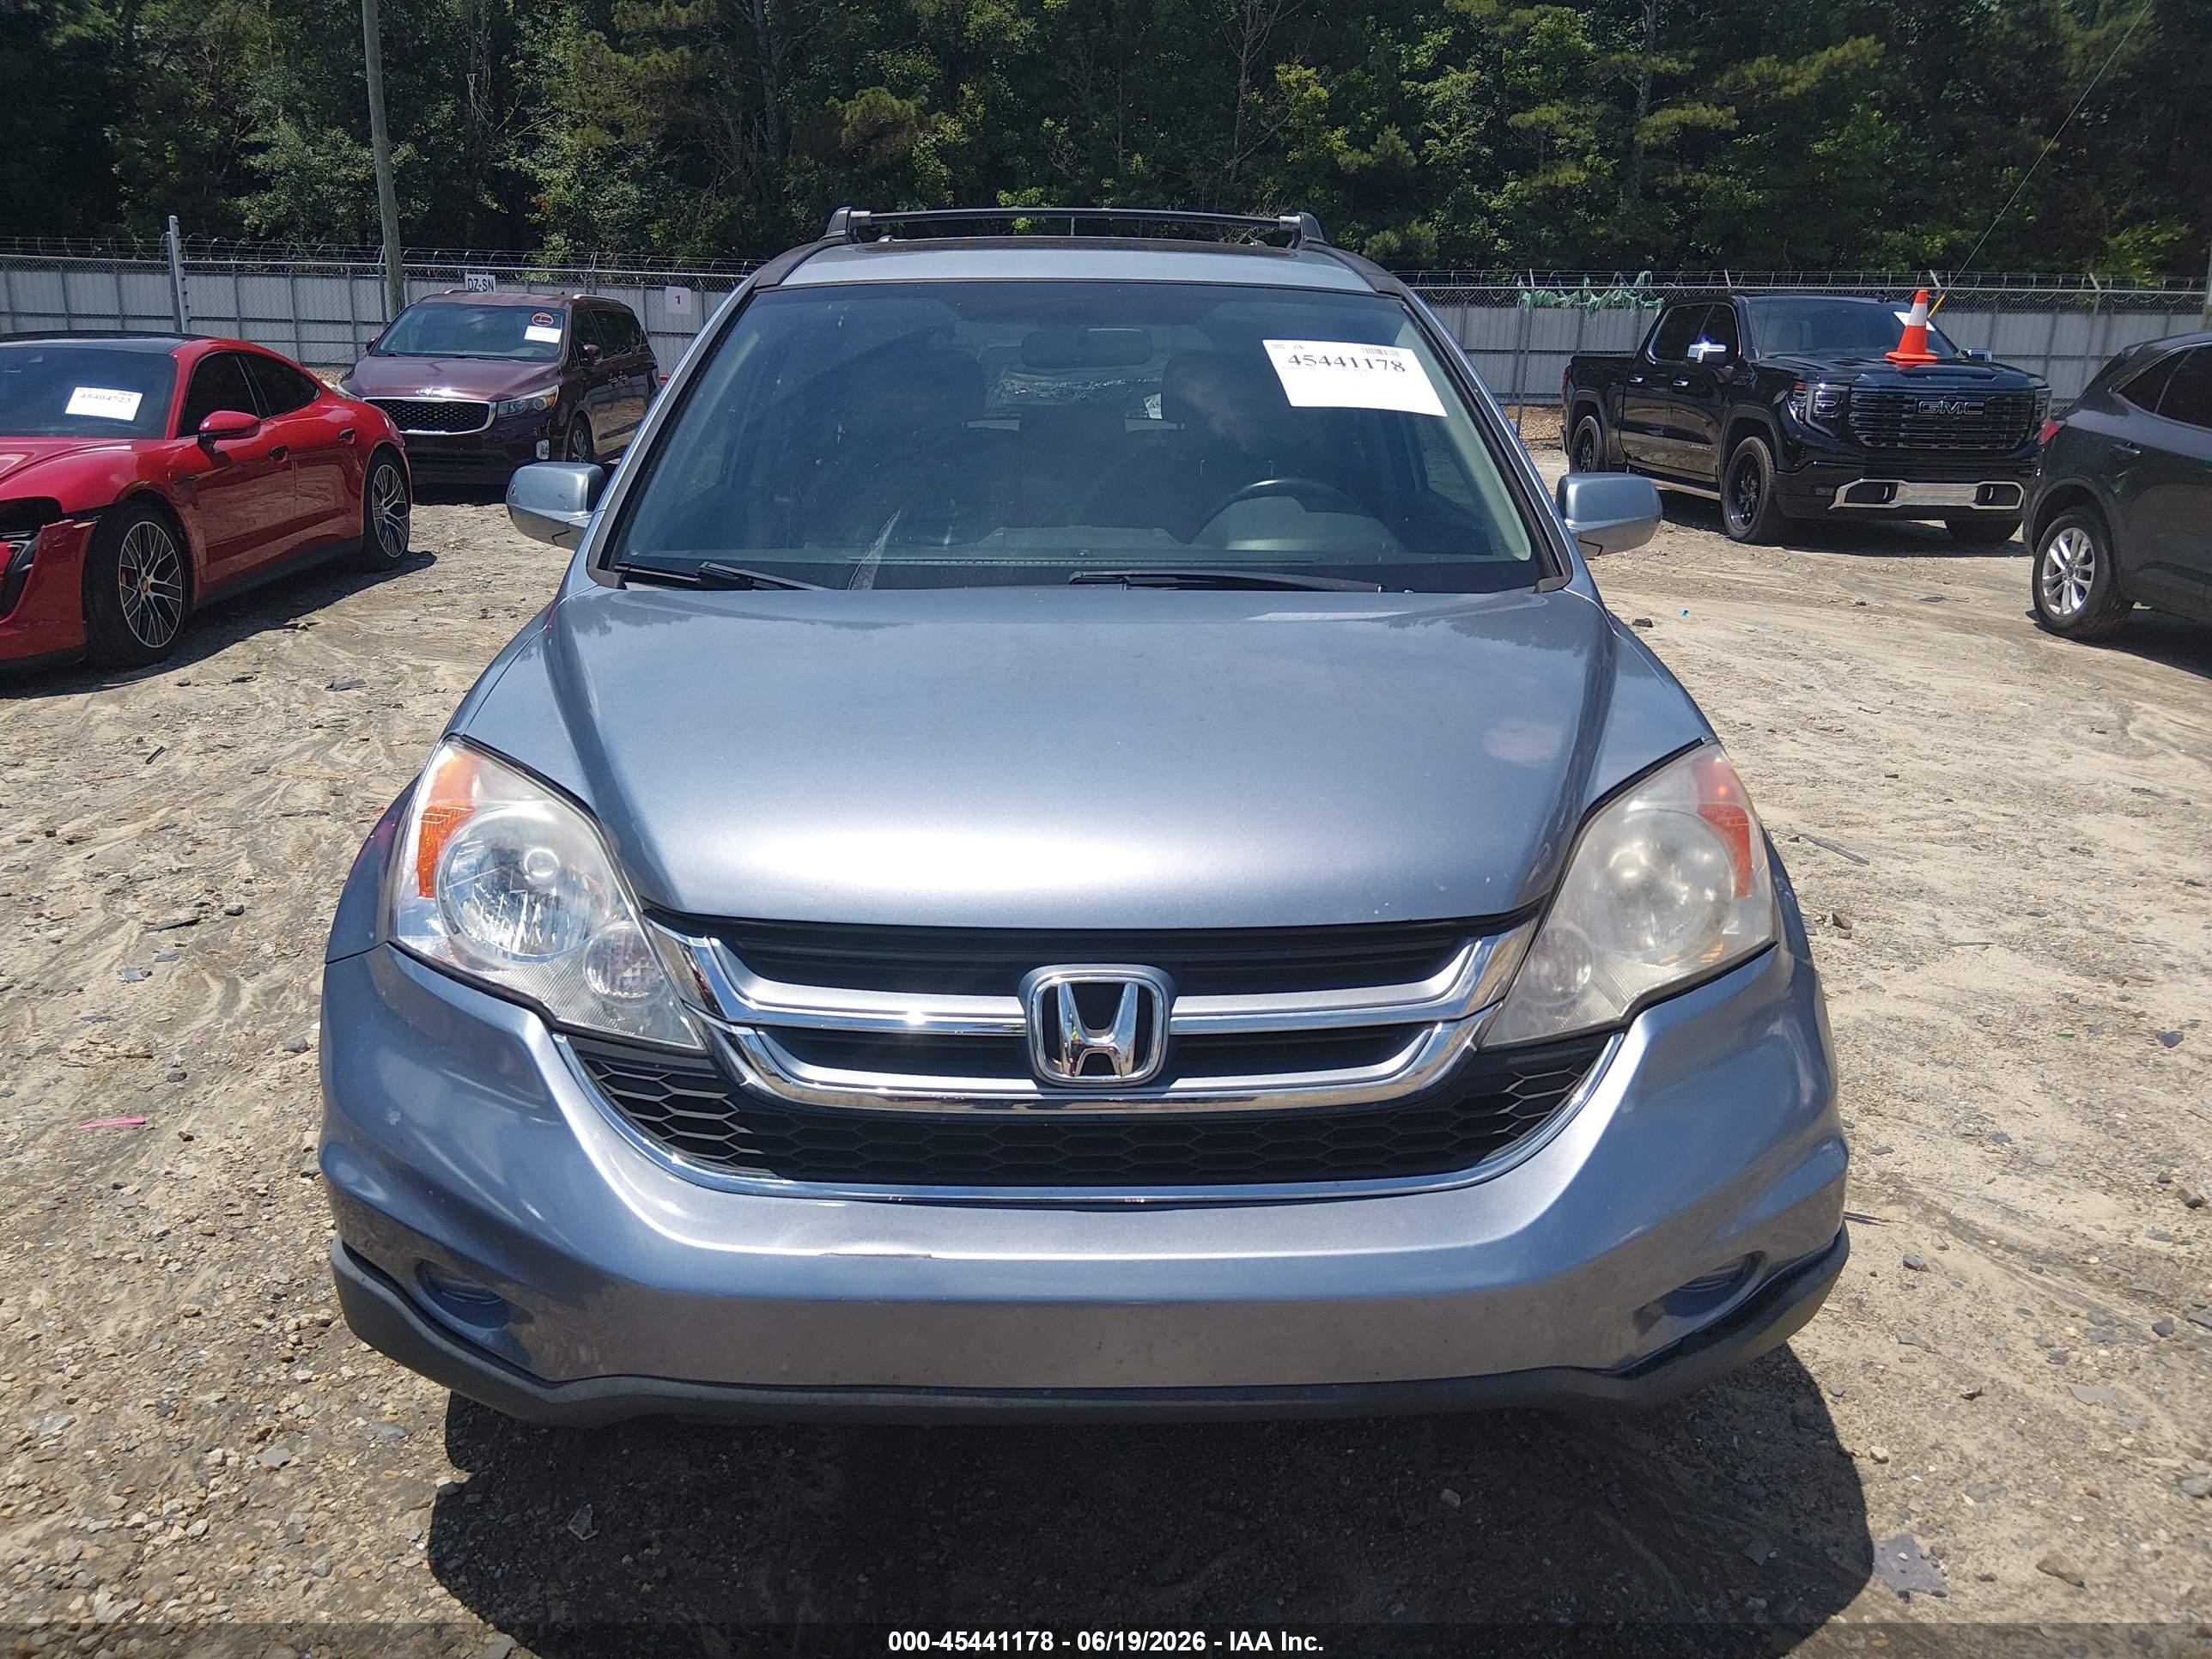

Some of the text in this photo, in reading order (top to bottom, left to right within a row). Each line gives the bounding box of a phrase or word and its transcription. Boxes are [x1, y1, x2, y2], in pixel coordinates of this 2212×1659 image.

[467, 277, 495, 293] DZ-SN
[675, 295, 681, 305] 1
[1287, 354, 1407, 373] 45441178
[1917, 400, 1985, 416] GMC
